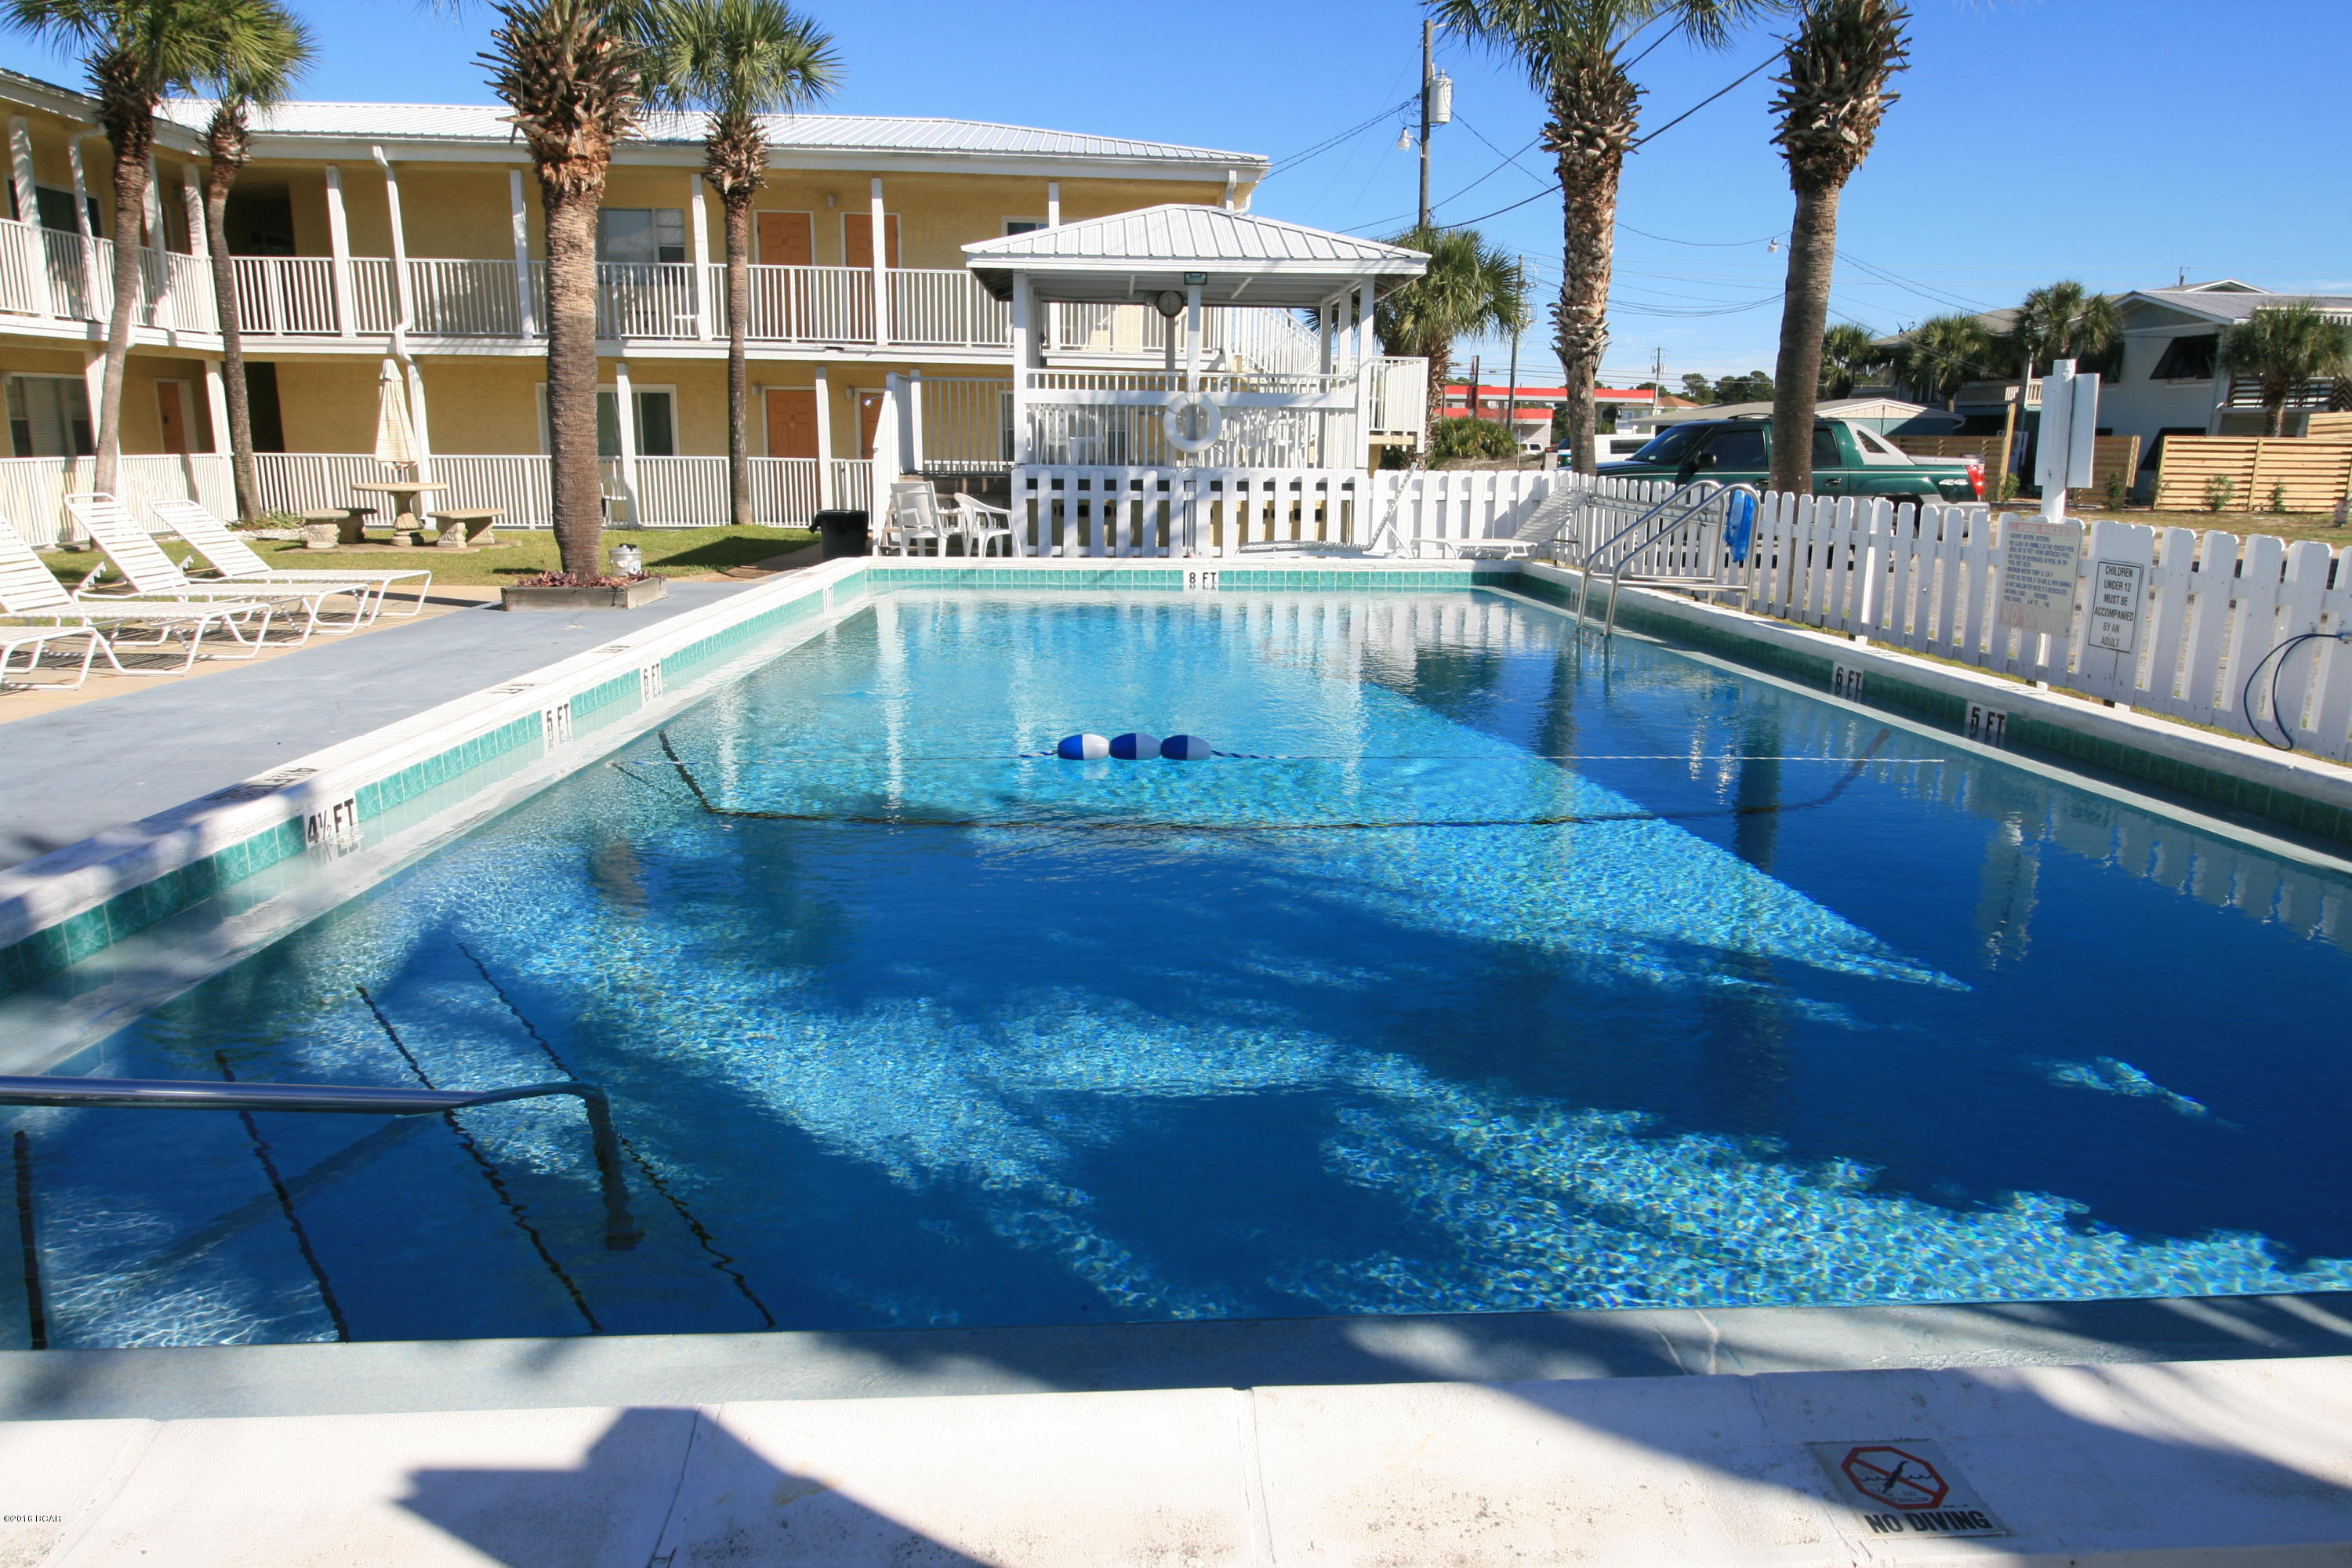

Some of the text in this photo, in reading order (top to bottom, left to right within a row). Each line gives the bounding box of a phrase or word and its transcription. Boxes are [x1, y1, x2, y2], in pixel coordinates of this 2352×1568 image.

[2018, 524, 2067, 535] POOL RULES
[2105, 565, 2132, 577] CHILDREN
[1189, 572, 1196, 584] 8
[2104, 579, 2132, 592] UNDER 12
[2103, 593, 2129, 606] MUST BE
[2094, 607, 2134, 621] ACCOMPANIED
[2103, 622, 2120, 633] BY AN
[2100, 636, 2120, 648] ADULT
[643, 668, 649, 687] 6
[1835, 666, 1844, 685] 6
[546, 710, 554, 731] 5
[1970, 706, 1980, 728] 5
[1864, 1510, 1993, 1534] NO DIVING
